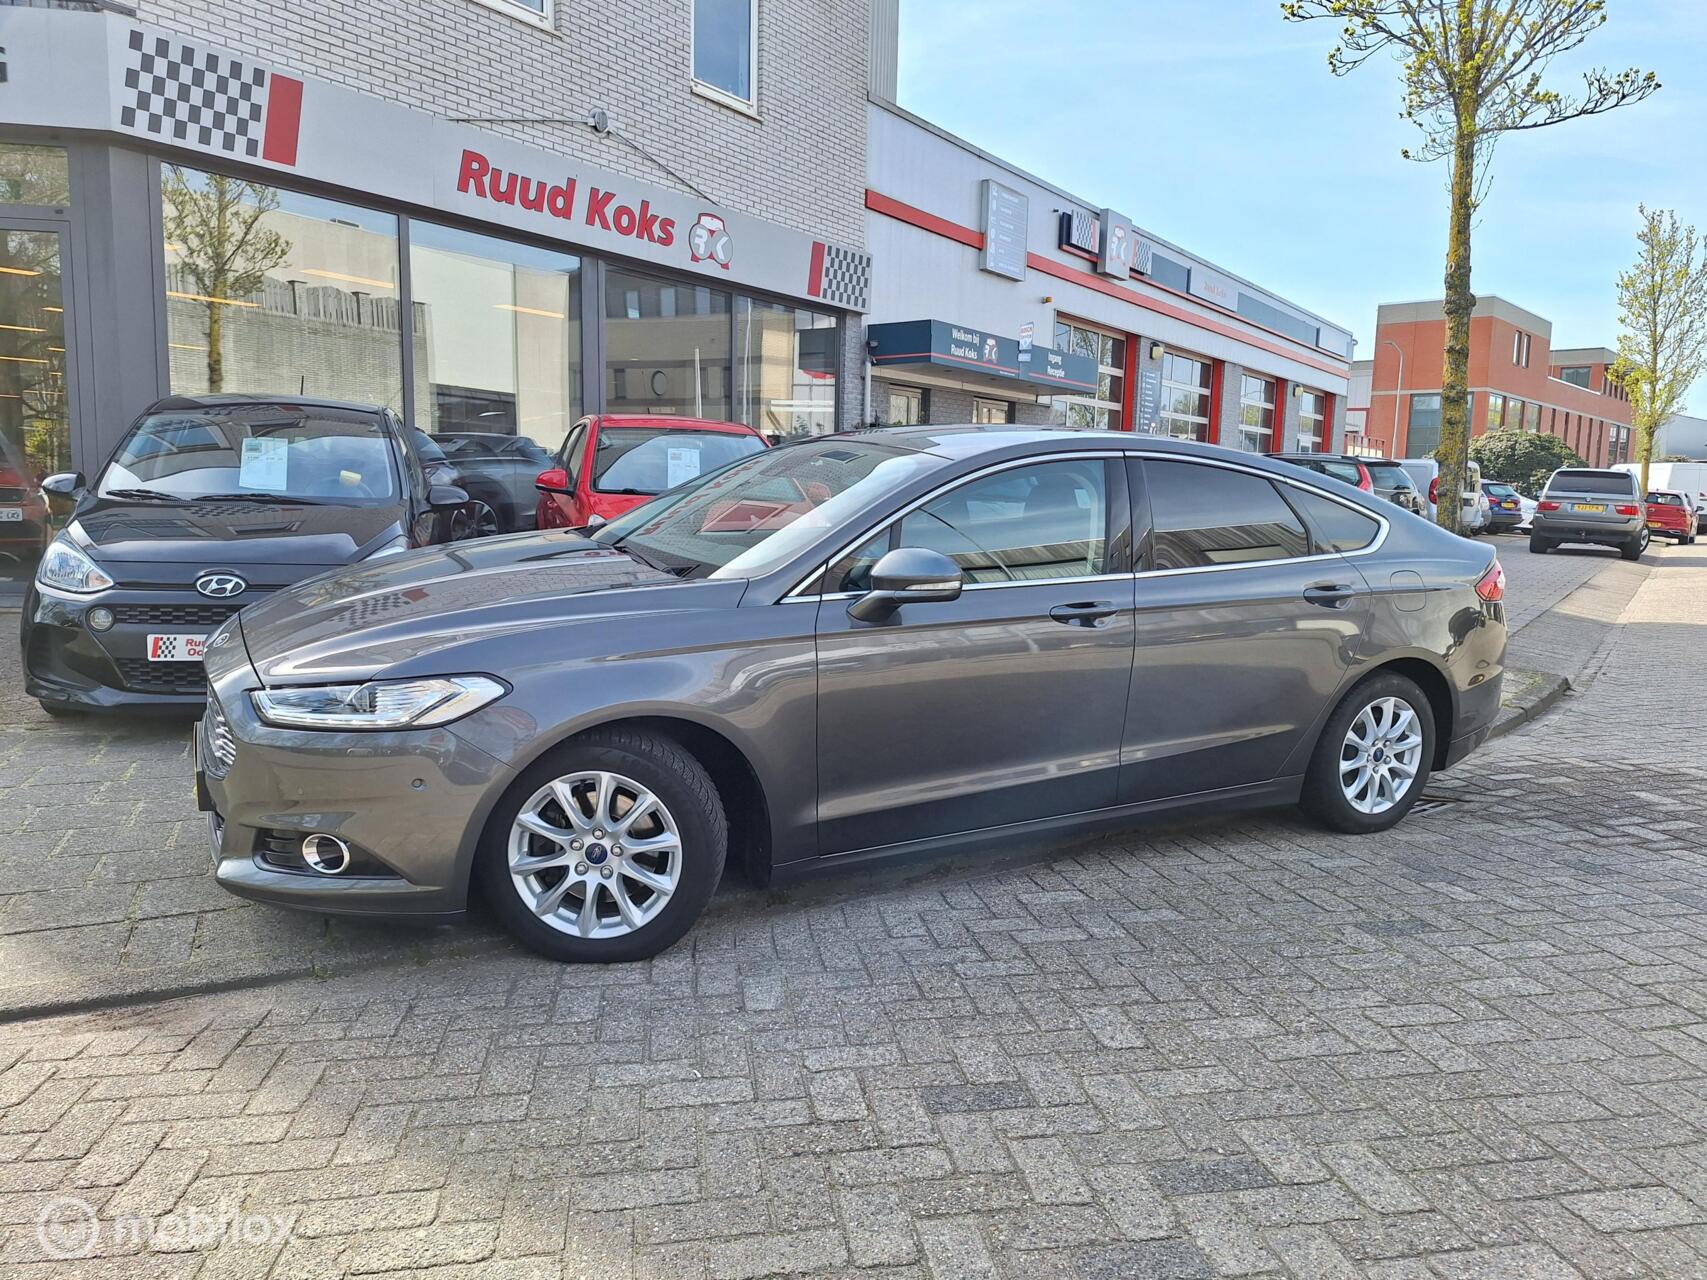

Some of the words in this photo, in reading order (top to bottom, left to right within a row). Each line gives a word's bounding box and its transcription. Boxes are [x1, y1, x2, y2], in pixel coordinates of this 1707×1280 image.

[456, 149, 577, 220] Ruud
[585, 187, 676, 247] Koks
[951, 328, 973, 343] Welkom
[950, 343, 965, 357] Ruud
